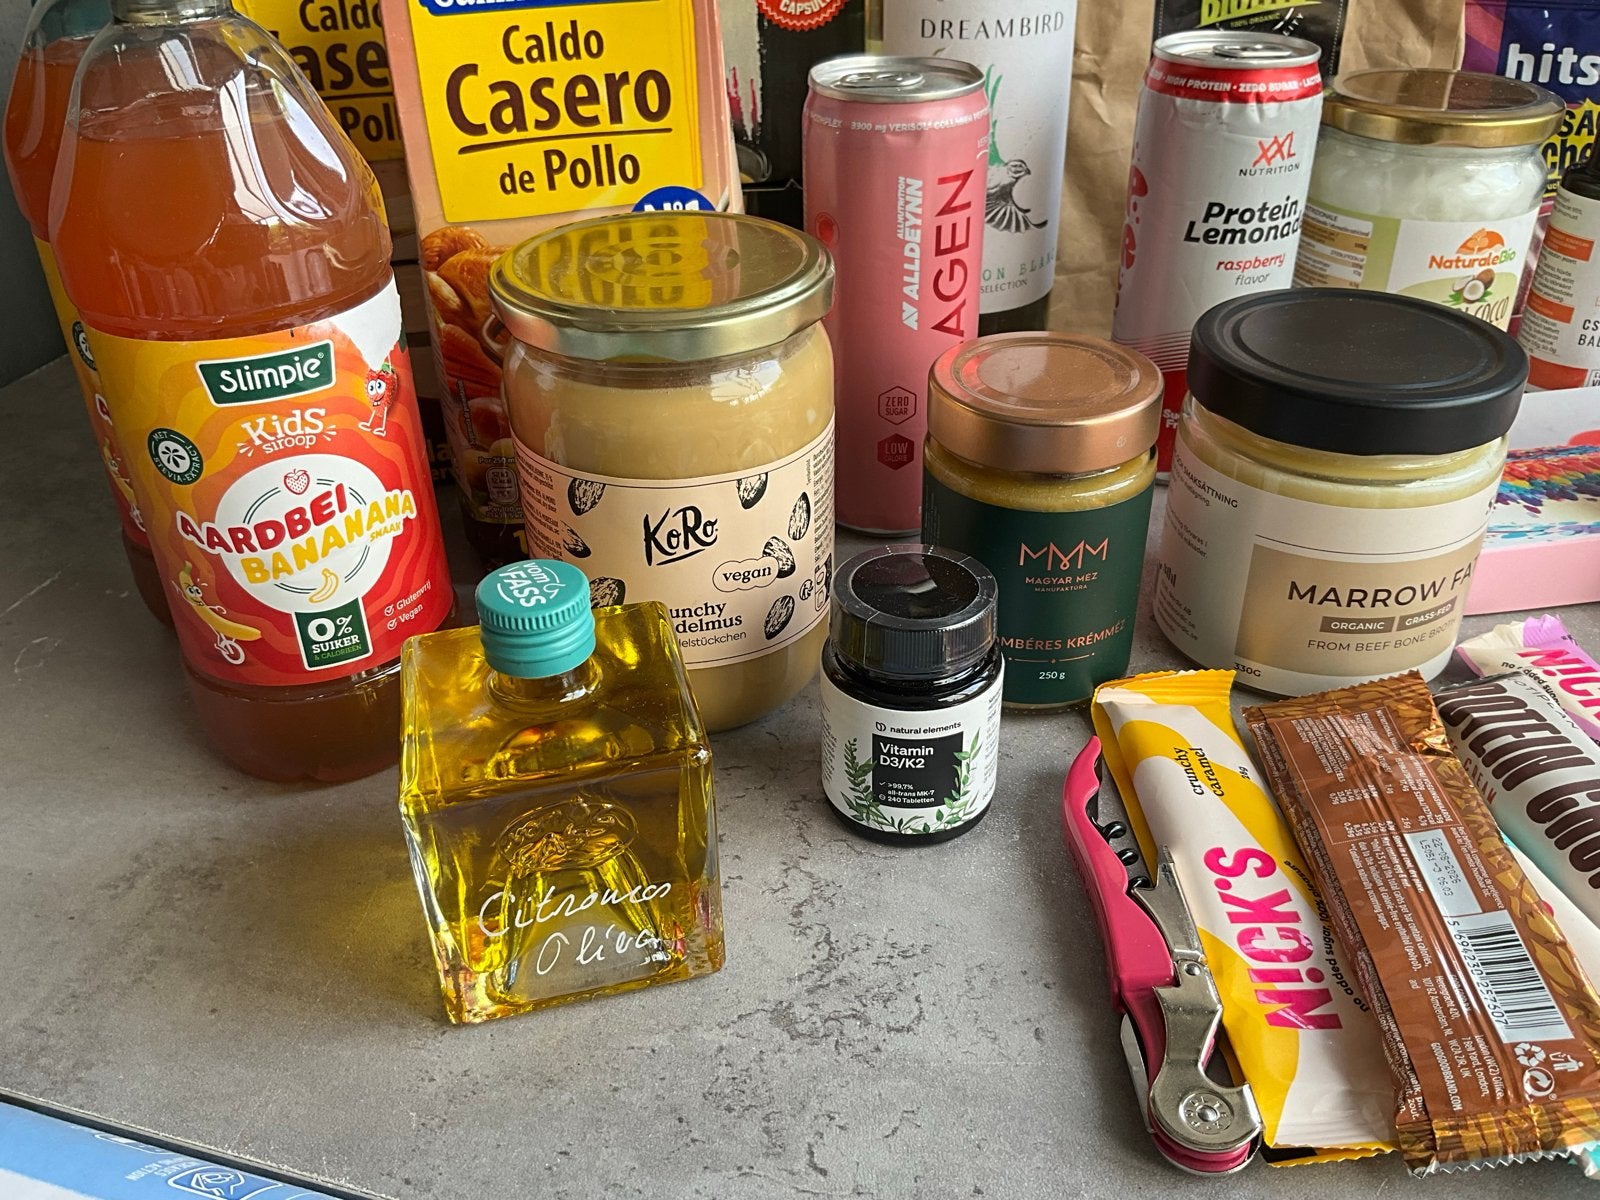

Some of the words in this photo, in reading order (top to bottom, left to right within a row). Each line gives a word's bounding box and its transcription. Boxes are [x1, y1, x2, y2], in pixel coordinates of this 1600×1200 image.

[920, 11, 1065, 40] DREAMBIRD
[502, 20, 604, 65] Caldo
[1187, 79, 1231, 92] PROTEIN
[446, 63, 672, 137] Casero
[339, 103, 402, 143] Pol
[1252, 131, 1296, 167] XXL
[499, 162, 535, 195] de
[543, 143, 641, 191] Pollo
[1238, 161, 1300, 177] NUTRITION
[1203, 196, 1298, 225] Protein
[902, 177, 924, 301] ALLDEYNN
[931, 169, 975, 340] AGEN
[1216, 253, 1286, 273] raspberry
[980, 279, 1028, 294] SELECTION
[1234, 272, 1270, 287] flavor
[885, 396, 909, 407] ZERO
[885, 407, 909, 416] SUGAR
[151, 430, 170, 442] MET
[263, 434, 317, 455] siroop
[885, 441, 909, 455] LOW
[180, 483, 348, 553] AARDBEI
[370, 522, 402, 542] SMAAK
[643, 505, 718, 567] KoRo
[523, 562, 551, 583] vom
[722, 564, 772, 583] vegan
[1025, 576, 1073, 585] MAGYAR
[1076, 571, 1098, 583] MÉZ
[396, 580, 431, 611] Glutenvrij
[498, 570, 547, 607] FASS
[1287, 577, 1446, 608] MARROW
[398, 603, 424, 623] Vegan
[1330, 621, 1385, 630] ORGANIC
[1405, 604, 1452, 626] GRASS-FED
[308, 614, 353, 642] 0%
[675, 615, 743, 633] delmus
[1066, 619, 1126, 649] KRÉMMÉZ
[311, 634, 361, 654] SUIKER
[1307, 639, 1350, 651] FROM
[1355, 641, 1390, 652] BEEF
[1394, 634, 1426, 648] BONE
[1038, 671, 1058, 680] 250
[1059, 672, 1066, 680] g
[1234, 662, 1262, 678] 330G
[1501, 661, 1516, 669] no
[890, 724, 921, 734] natural
[923, 722, 962, 734] elements
[879, 741, 934, 756] Vitamin
[879, 755, 925, 769] D3/K2
[1173, 747, 1204, 796] crunchy
[1189, 747, 1225, 797] caramel
[902, 796, 935, 804] Tabletten
[916, 789, 935, 797] MK-7
[1385, 847, 1399, 863] contain
[1392, 865, 1403, 873] egg
[1357, 842, 1368, 850] due
[1368, 866, 1384, 884] inclusion
[1380, 892, 1401, 919] calorie-free
[1392, 922, 1412, 945] erythritol
[1387, 878, 1399, 889] total
[1356, 869, 1373, 888] naturally
[1365, 890, 1383, 911] occurring
[1375, 913, 1390, 929] sugars.
[1392, 891, 1405, 902] carbs
[1407, 923, 1423, 940] contain
[1415, 945, 1431, 965] calories,
[1331, 958, 1354, 997] added
[1408, 978, 1420, 989] and
[1451, 933, 1484, 975] 694230
[1474, 981, 1510, 1025] 257607
[1433, 975, 1455, 1008] Herengracht
[1353, 996, 1370, 1013] no
[1427, 994, 1450, 1027] Amsterdam,
[1447, 1039, 1461, 1054] WC2A
[1459, 1067, 1472, 1077] UK
[1473, 1034, 1491, 1055] London
[1482, 1056, 1499, 1075] (WC2)
[1428, 1042, 1466, 1110] GOODGOODBRAND.COM
[1463, 1041, 1475, 1051] Bell
[1471, 1068, 1492, 1095] London,
